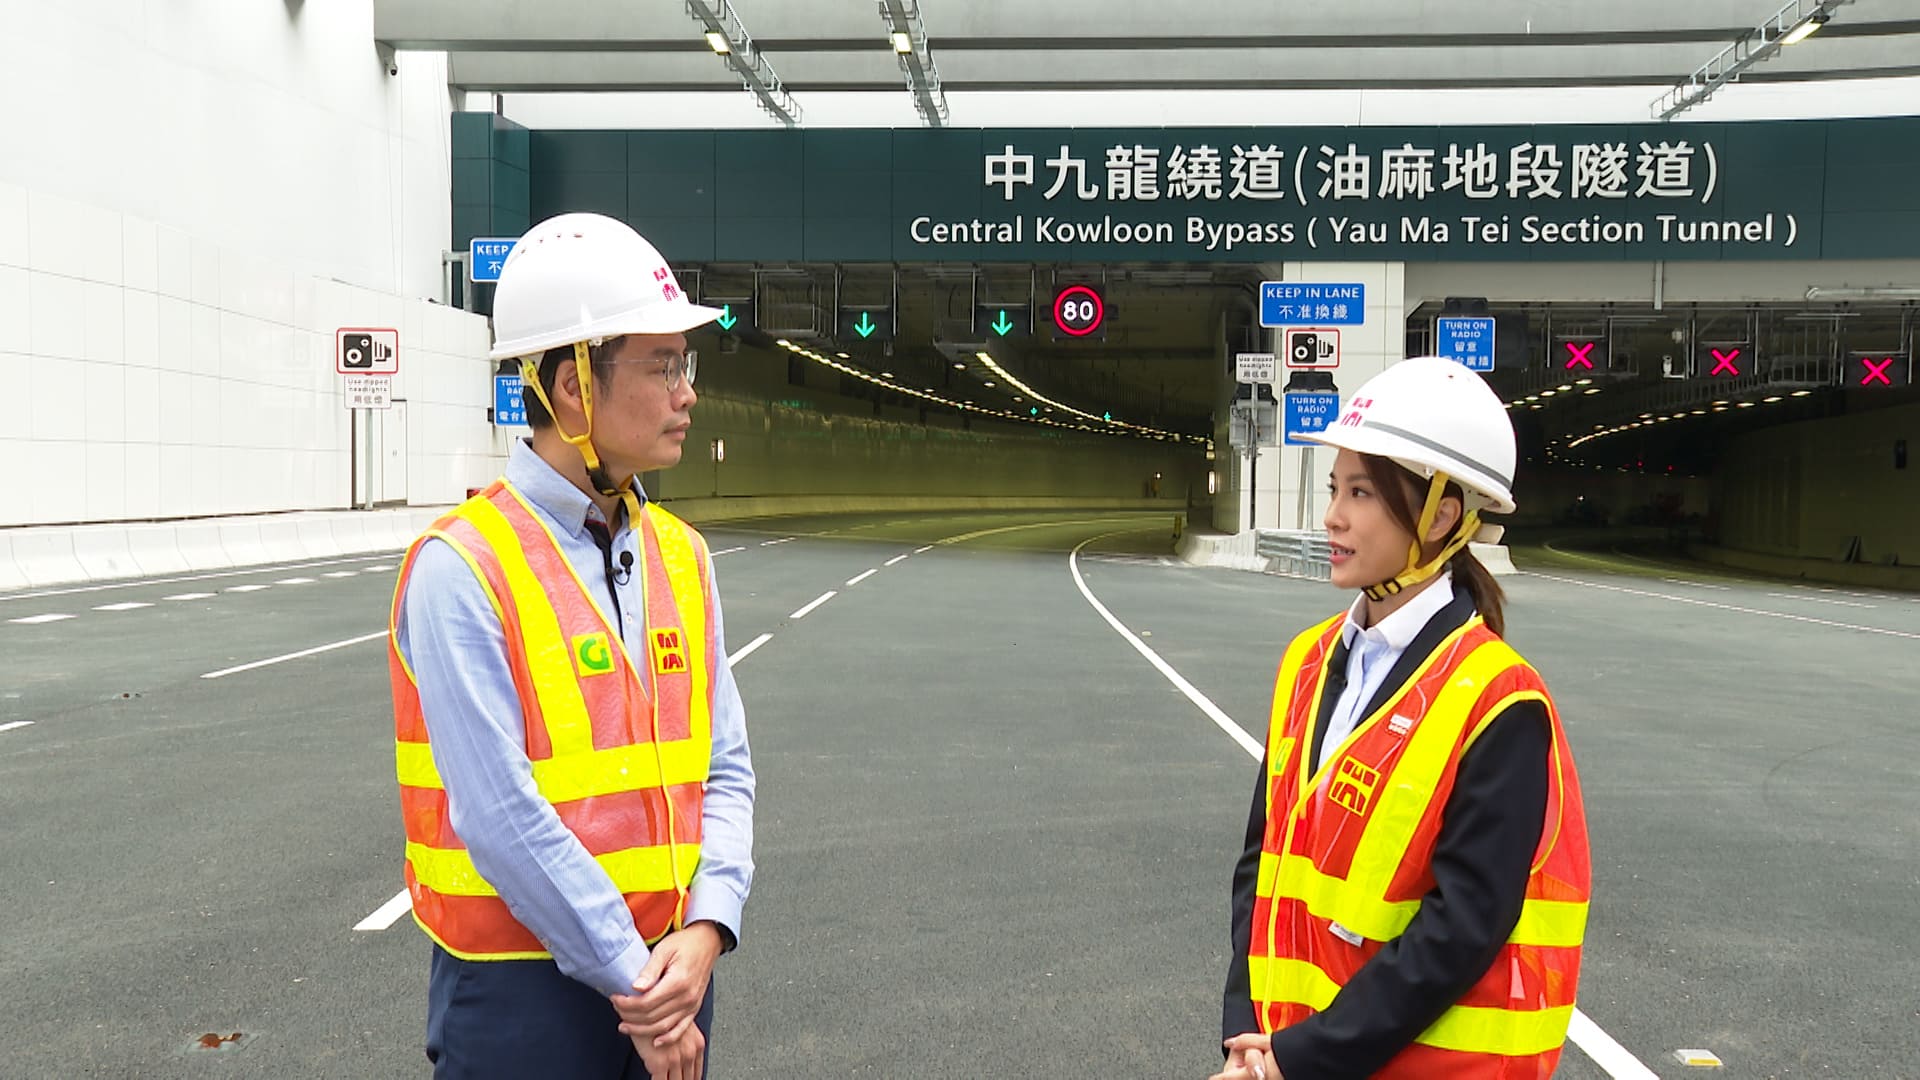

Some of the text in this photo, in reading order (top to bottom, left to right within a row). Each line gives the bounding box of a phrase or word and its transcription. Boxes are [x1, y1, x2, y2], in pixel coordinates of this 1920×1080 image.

[984, 142, 1718, 206] 中九龍繞道(油麻地段隧道)
[910, 216, 1023, 243] Central
[1036, 216, 1174, 243] Kowloon
[1186, 216, 1295, 250] Bypass
[1329, 216, 1388, 243] Yau
[1399, 216, 1449, 243] Ma
[1461, 215, 1509, 243] Tei
[1521, 215, 1644, 243] Section
[1656, 214, 1773, 242] Tunnel
[476, 244, 509, 256] KEEP
[1266, 287, 1360, 298] KEEP IN LANE
[1063, 300, 1094, 321] 80
[1445, 321, 1487, 330] TURN ON
[1297, 405, 1327, 413] RADIO
